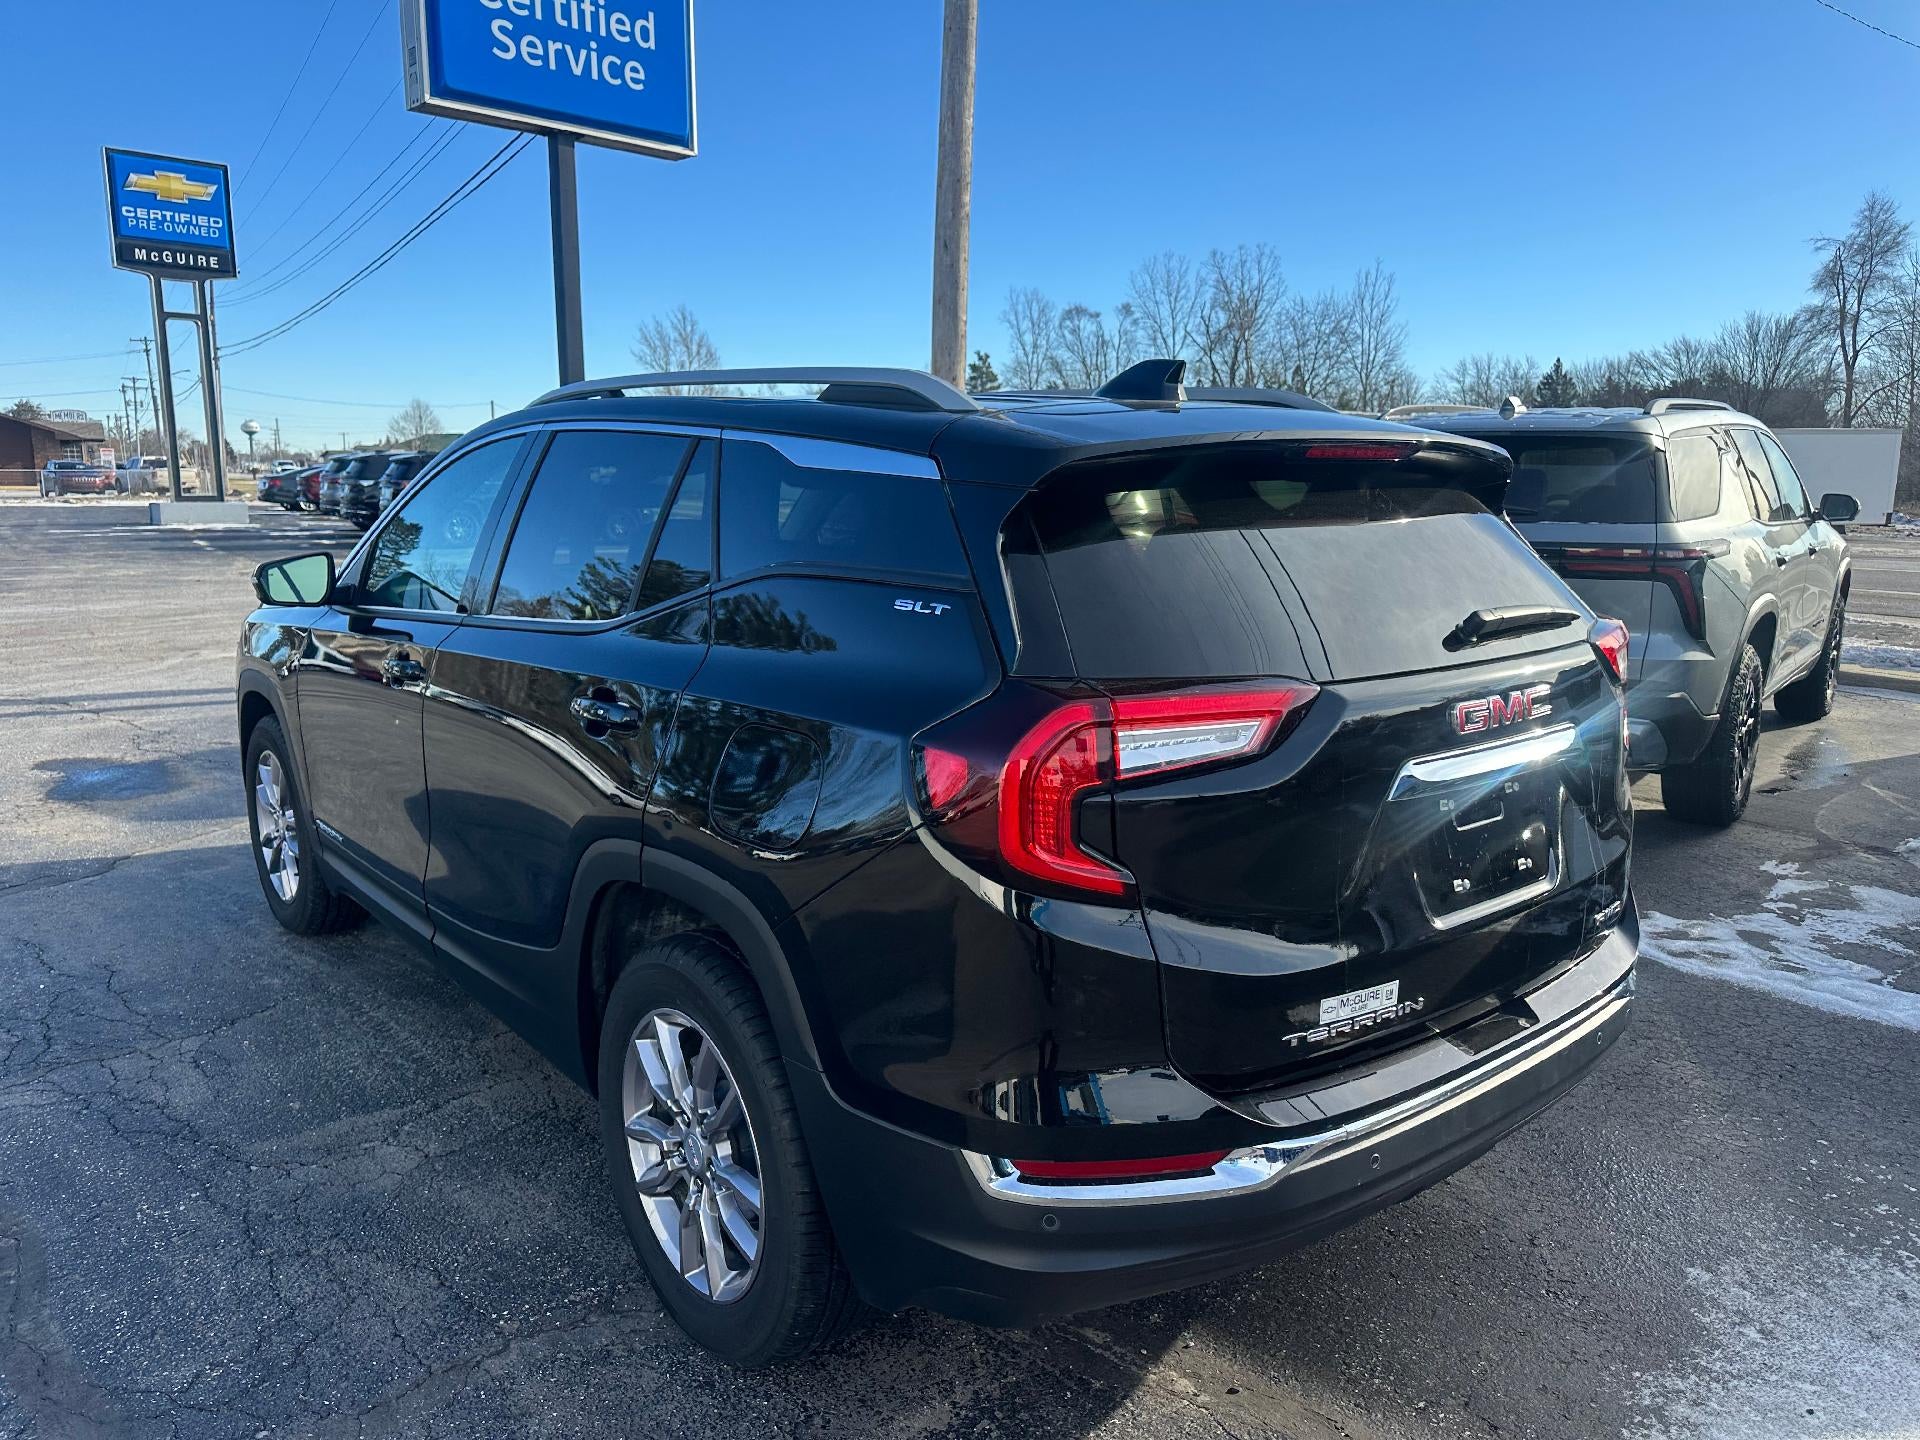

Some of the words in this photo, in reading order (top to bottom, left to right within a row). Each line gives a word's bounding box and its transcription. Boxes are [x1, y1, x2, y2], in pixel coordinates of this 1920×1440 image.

[490, 18, 646, 91] Service
[121, 206, 223, 228] CERTIFIED
[128, 218, 219, 238] PRE-OWNED
[134, 248, 219, 268] McGUIRE
[893, 599, 952, 615] SLT
[1455, 684, 1553, 735] GMC
[1340, 989, 1380, 1009] McGUIRE
[1281, 996, 1425, 1047] TERRAIN
